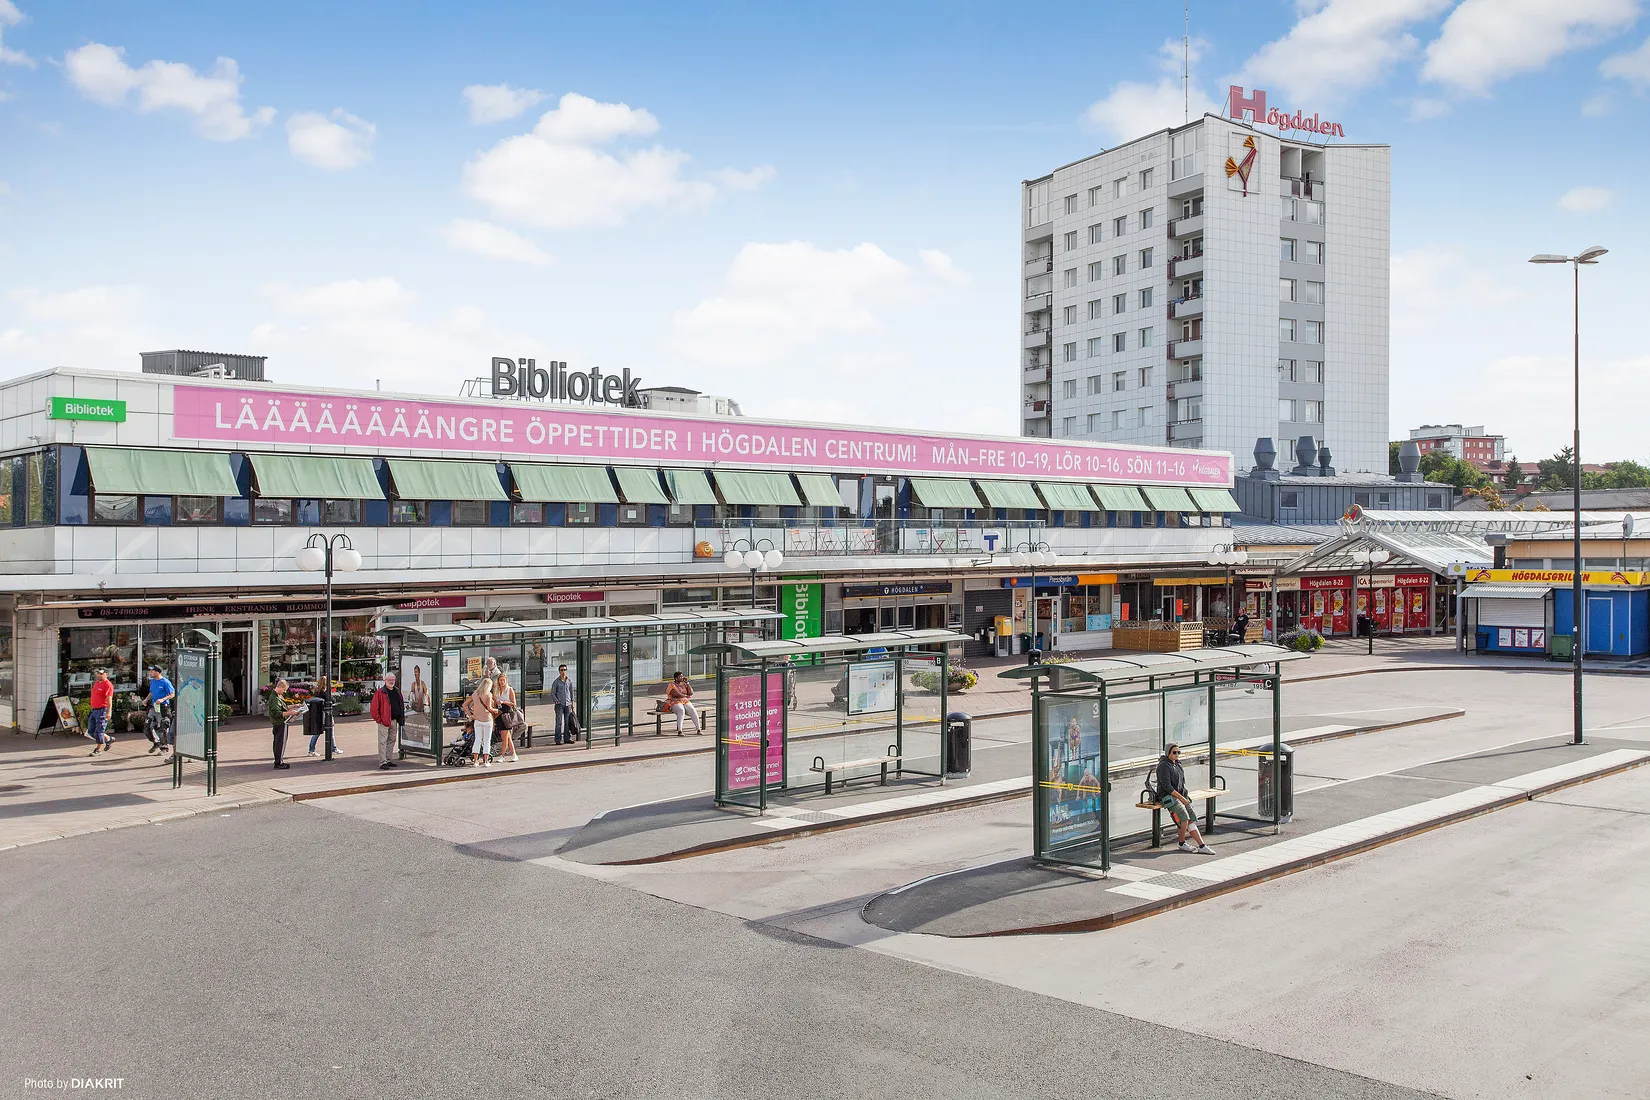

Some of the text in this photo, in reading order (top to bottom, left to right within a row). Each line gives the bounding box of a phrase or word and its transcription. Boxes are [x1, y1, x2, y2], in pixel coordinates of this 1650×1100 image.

[1230, 85, 1345, 137] Högdalen
[491, 356, 643, 407] Bibliotek
[65, 403, 114, 417] Bibliotek
[525, 415, 678, 452] ÖPPETTIDER
[687, 431, 692, 452] I
[702, 429, 818, 459] HÖGDALEN
[825, 439, 917, 464] CENTRUM!
[1056, 448, 1081, 472] LÖR
[1127, 454, 1153, 475] SÖN
[1198, 466, 1221, 475] HÖGDALEN
[983, 534, 999, 551] T
[1049, 576, 1073, 584] Pressbyrån
[1357, 577, 1367, 585] ICA
[1397, 577, 1418, 585] Högdalen
[1511, 571, 1590, 582] HÖGDALSGRILN
[1309, 579, 1332, 588] Högdalen
[891, 586, 918, 594] HÖGDALEN
[547, 593, 582, 603] Klippotek
[100, 608, 149, 617] 08-7490396
[795, 584, 809, 661] Bibliotk
[622, 642, 628, 652] 3
[1265, 679, 1272, 688] C
[1092, 702, 1100, 715] 3
[735, 723, 746, 731] ser
[746, 721, 758, 730] det
